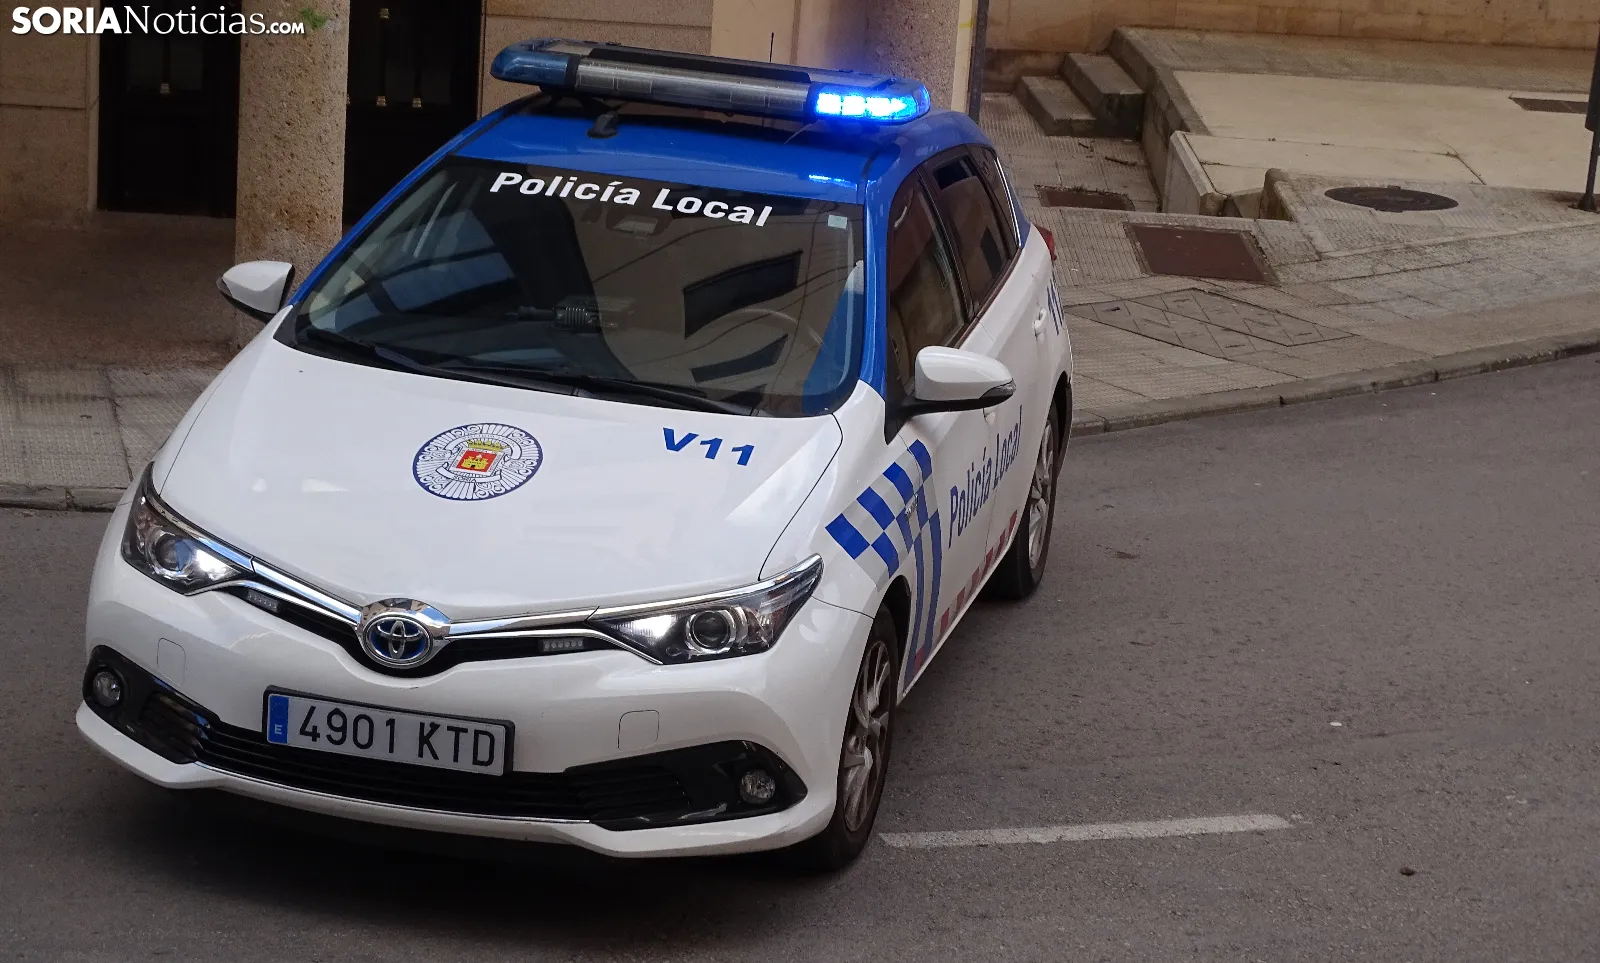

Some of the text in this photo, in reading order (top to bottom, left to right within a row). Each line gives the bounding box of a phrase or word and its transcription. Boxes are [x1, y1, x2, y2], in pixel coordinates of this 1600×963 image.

[490, 172, 773, 227] Policía Local
[662, 427, 756, 467] V11
[948, 404, 1023, 549] Policía Local
[274, 724, 283, 735] E
[299, 705, 496, 767] 4901 KTD
